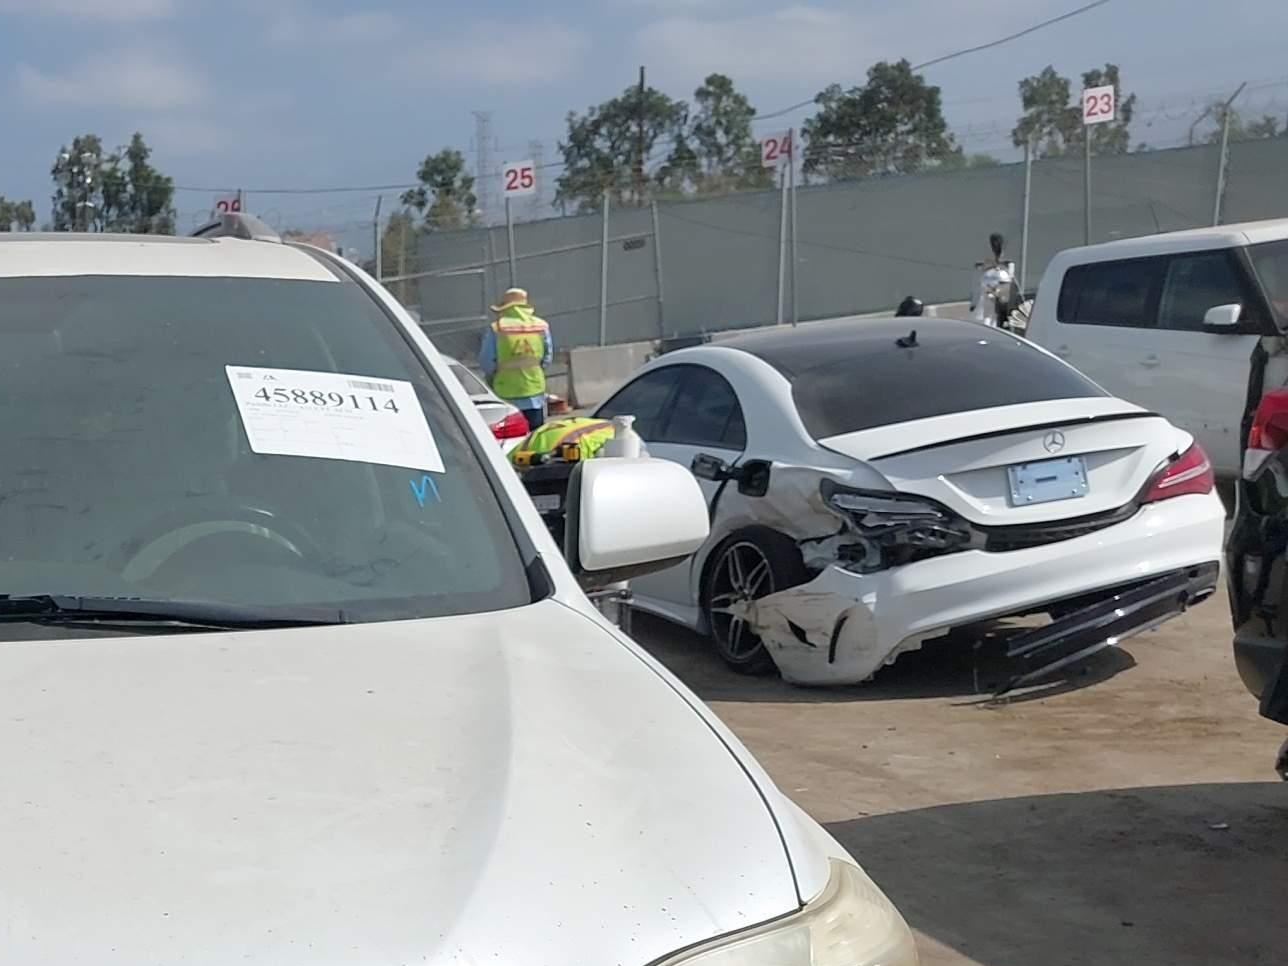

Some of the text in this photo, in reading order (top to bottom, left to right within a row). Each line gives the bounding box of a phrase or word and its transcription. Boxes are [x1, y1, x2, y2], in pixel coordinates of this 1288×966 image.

[1086, 92, 1113, 117] 23
[765, 138, 792, 162] 24
[505, 167, 534, 190] 25
[254, 386, 400, 414] 45889114
